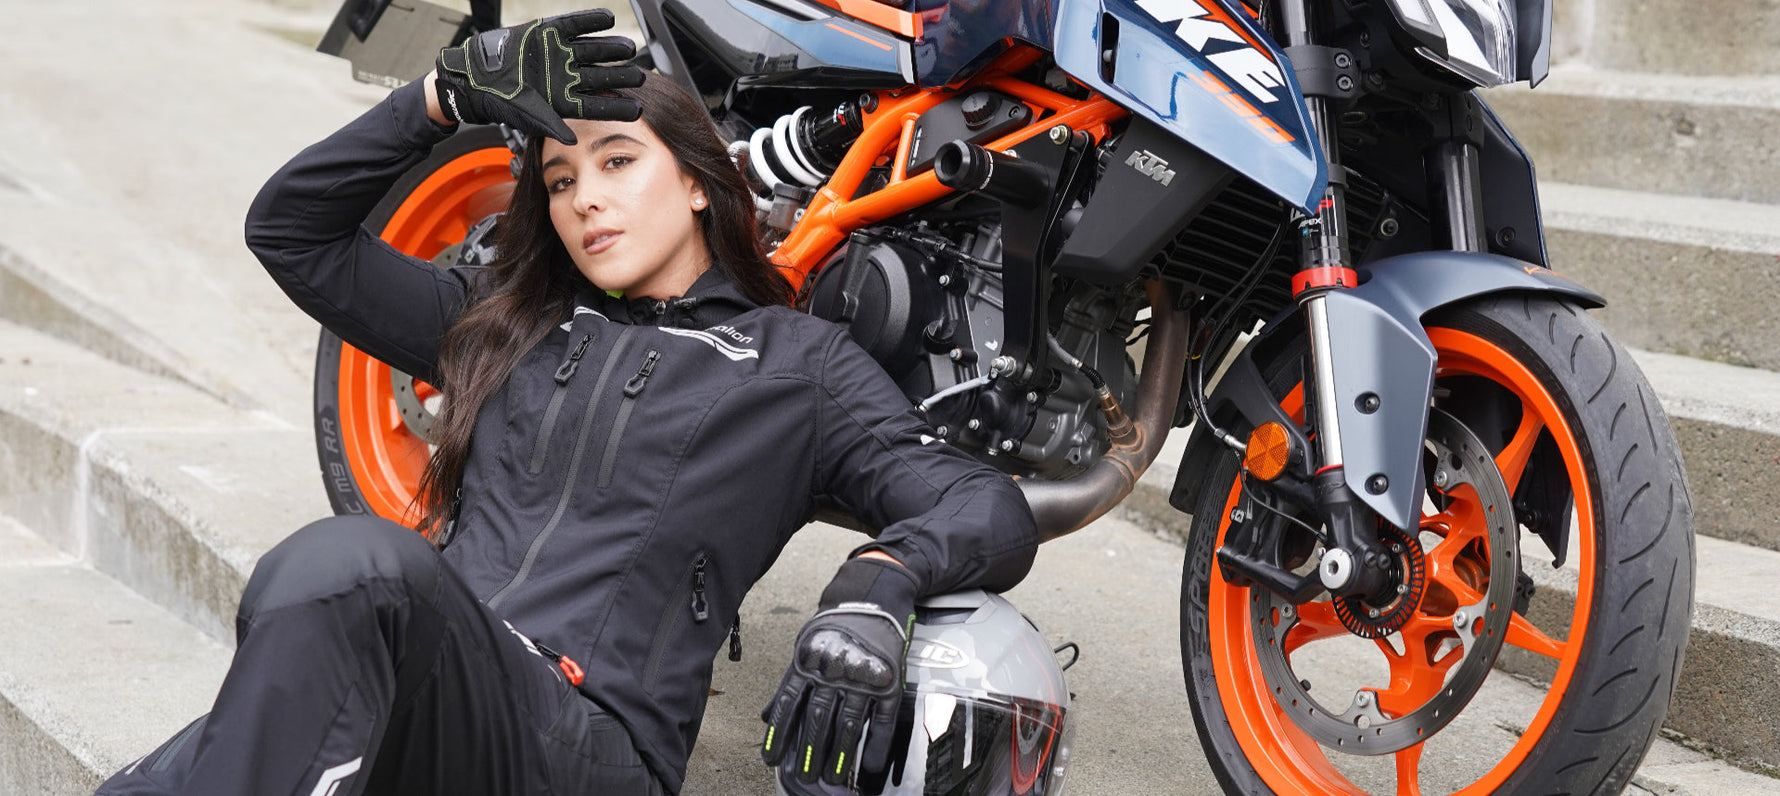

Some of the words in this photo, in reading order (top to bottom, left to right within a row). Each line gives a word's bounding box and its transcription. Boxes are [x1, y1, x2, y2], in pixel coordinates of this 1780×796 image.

[1186, 70, 1296, 144] 390
[1124, 150, 1176, 187] KTM
[322, 417, 339, 453] RR
